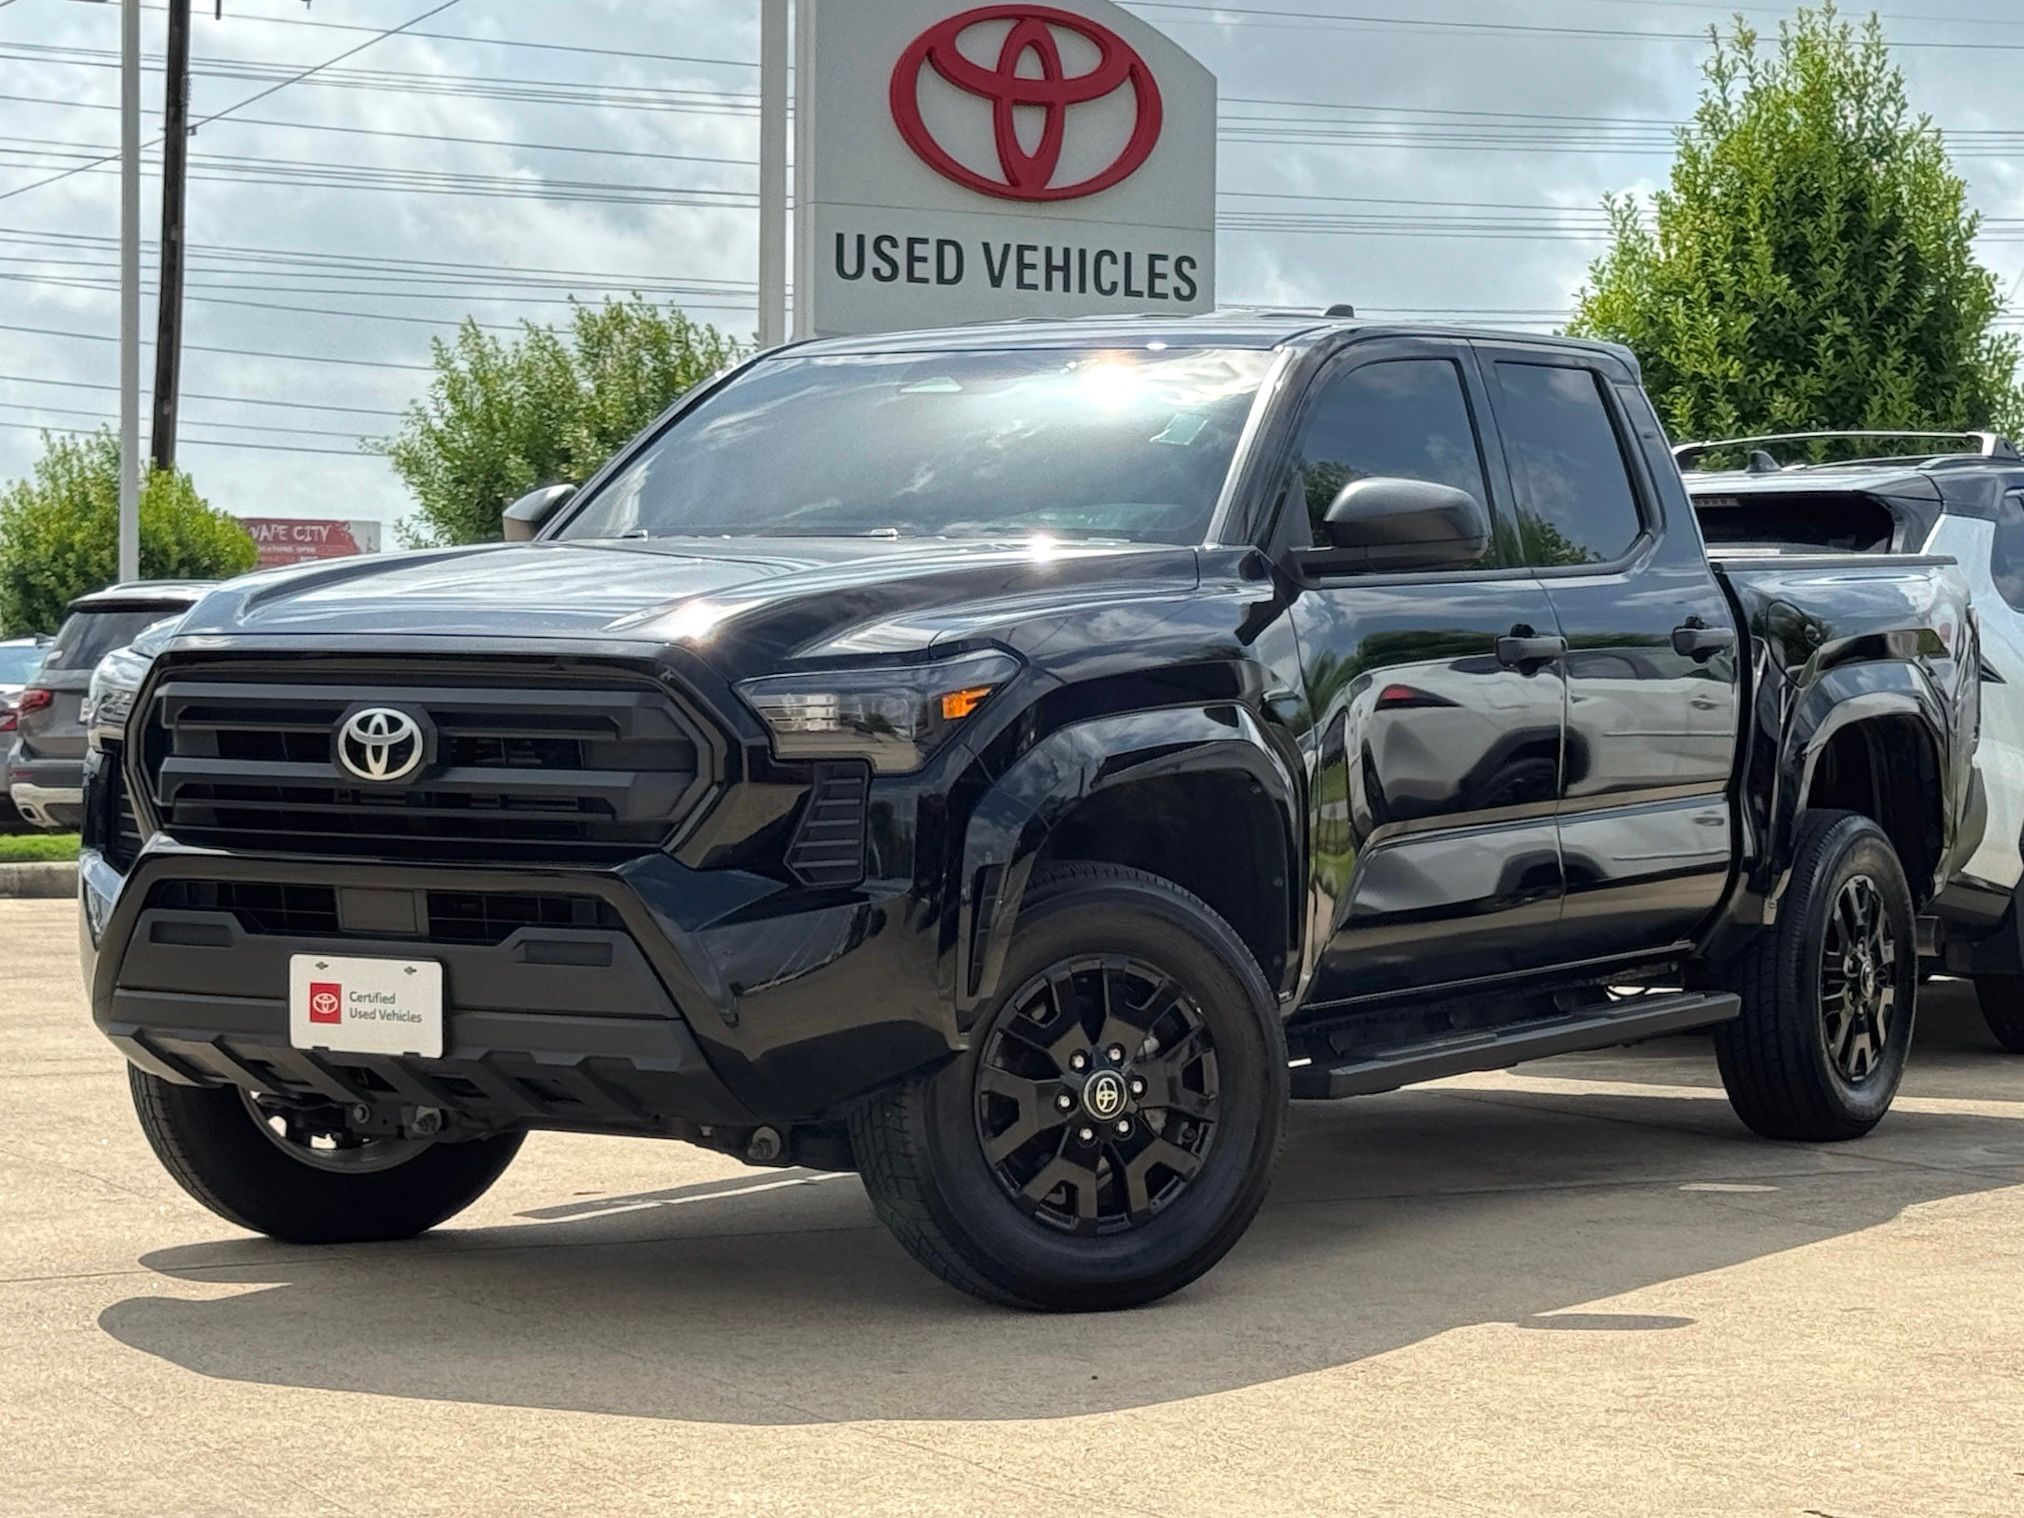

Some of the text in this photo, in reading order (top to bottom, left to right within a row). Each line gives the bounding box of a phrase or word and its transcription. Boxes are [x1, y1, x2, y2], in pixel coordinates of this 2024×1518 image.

[835, 232, 1198, 301] USED VEHICLES
[249, 524, 331, 542] VAPE CITY
[349, 991, 396, 1004] Certified
[349, 1008, 423, 1023] Used Vehicles
